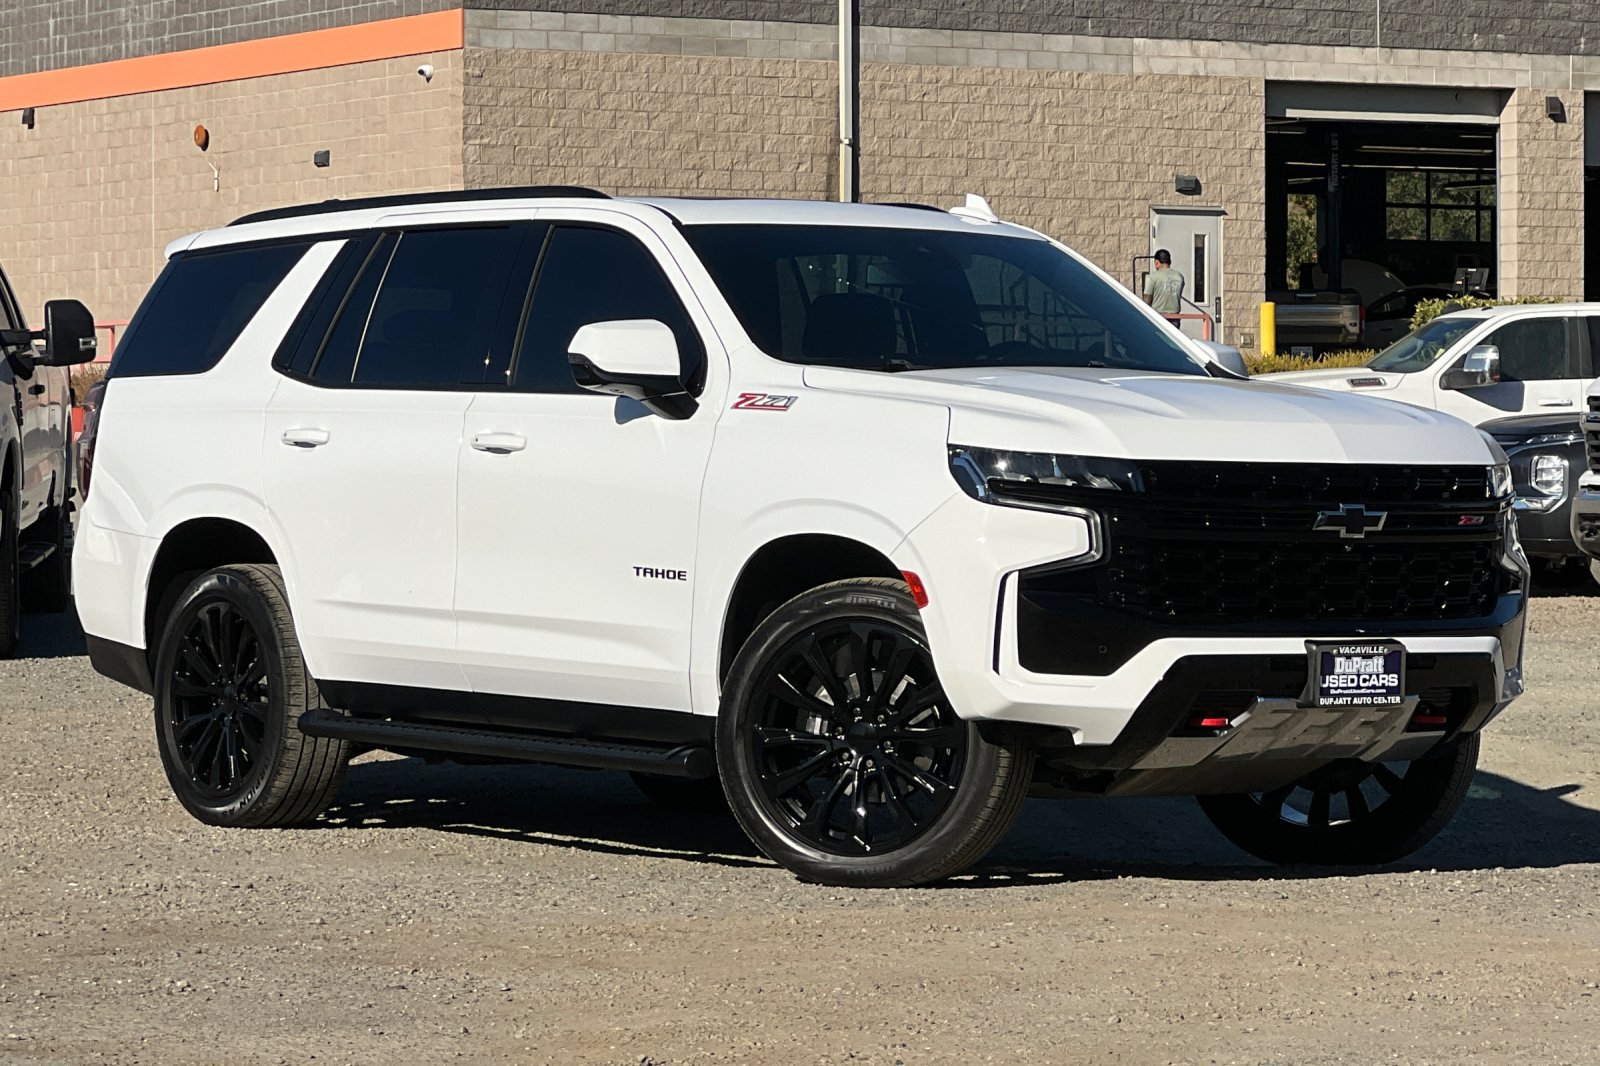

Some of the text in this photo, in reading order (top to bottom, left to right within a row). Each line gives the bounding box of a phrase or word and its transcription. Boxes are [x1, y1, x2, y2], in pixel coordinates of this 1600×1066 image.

[730, 393, 799, 412] Z71
[633, 566, 687, 581] TAHOE
[1339, 646, 1384, 654] VACAVILLE
[1334, 656, 1385, 674] DuPratt
[1320, 674, 1399, 688] USED CARS
[1352, 697, 1372, 705] AUTO
